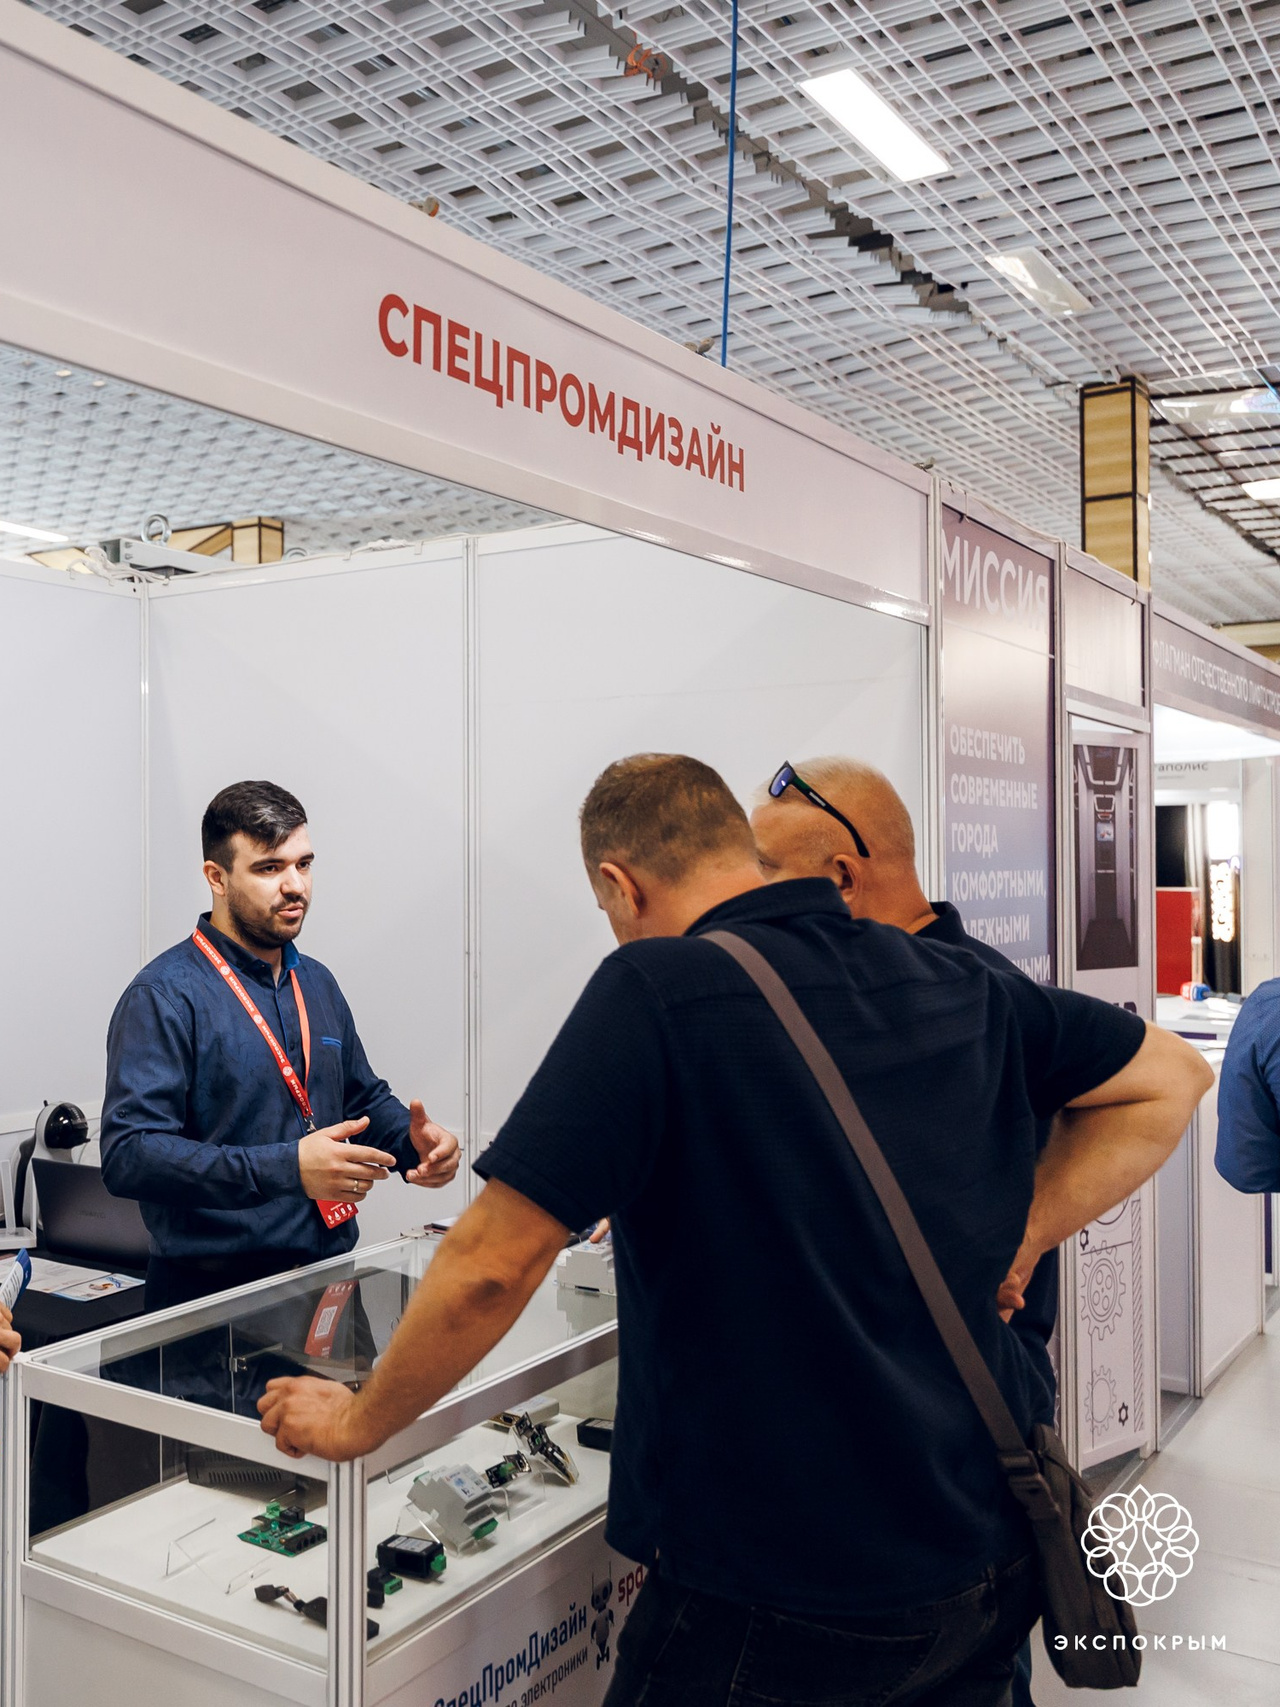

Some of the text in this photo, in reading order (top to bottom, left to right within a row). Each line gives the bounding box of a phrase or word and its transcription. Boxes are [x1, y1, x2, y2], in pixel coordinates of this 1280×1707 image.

[378, 293, 745, 492] СПЕЦПРОМДИЗАЙН
[940, 529, 1049, 634] МИССИЯ
[949, 724, 1026, 765] ОБЕСПЕЧИТЬ
[1155, 762, 1209, 772] аполис
[950, 773, 1039, 810] СОВРЕМЕННЫЕ
[951, 823, 999, 858] ГОРОДА
[963, 914, 1030, 946] ДЕЖНЫМИ
[520, 1646, 588, 1707] электроники
